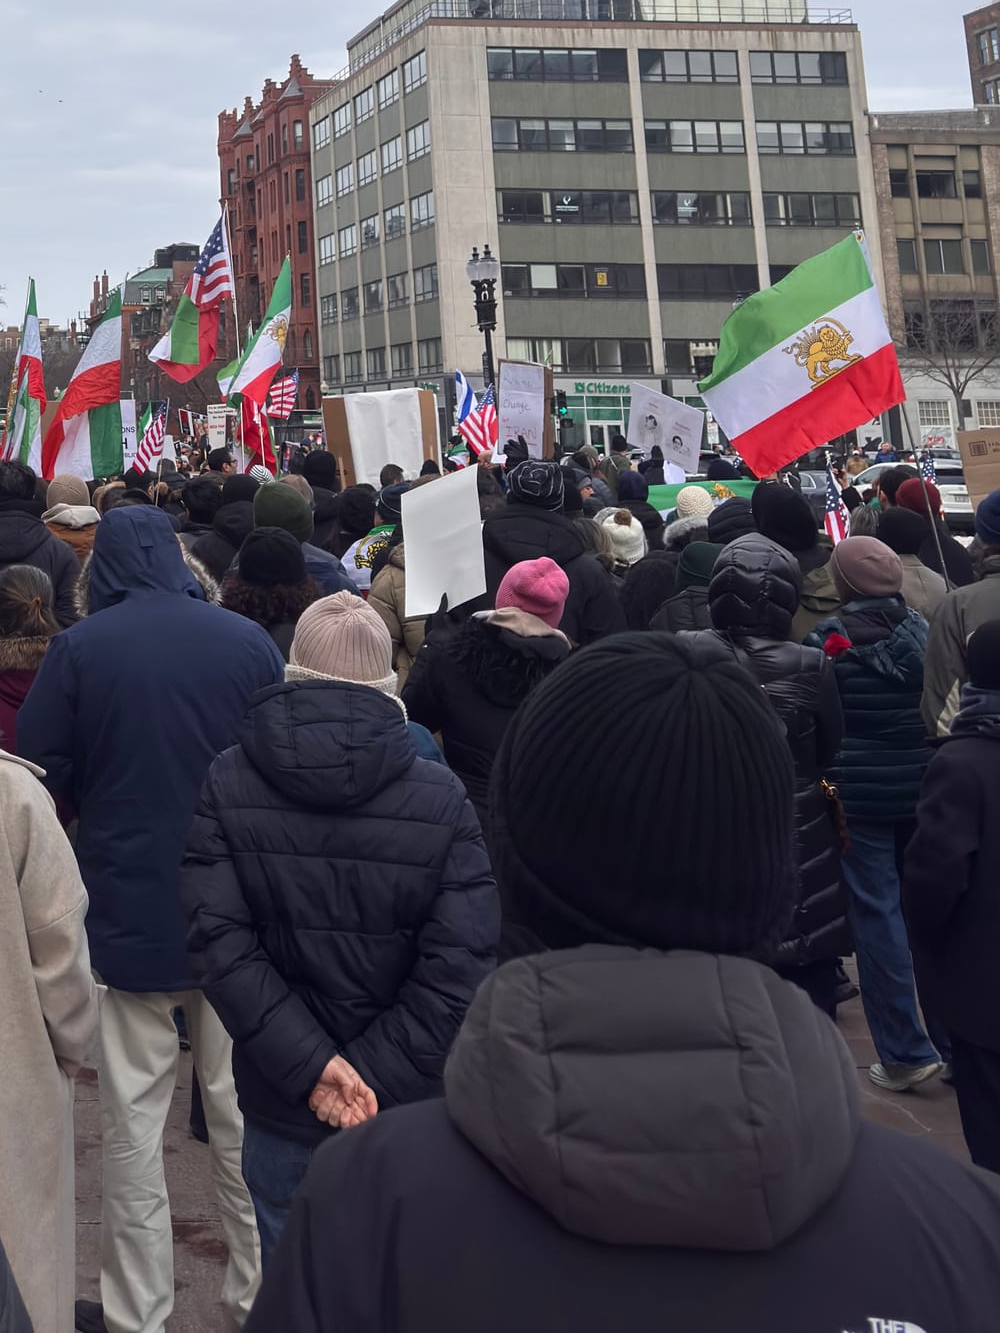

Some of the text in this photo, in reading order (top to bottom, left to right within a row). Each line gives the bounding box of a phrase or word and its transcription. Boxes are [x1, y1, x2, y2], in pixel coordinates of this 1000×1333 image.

[586, 382, 631, 394] Citizens
[505, 425, 537, 440] IRAN
[867, 1317, 906, 1333] THE
